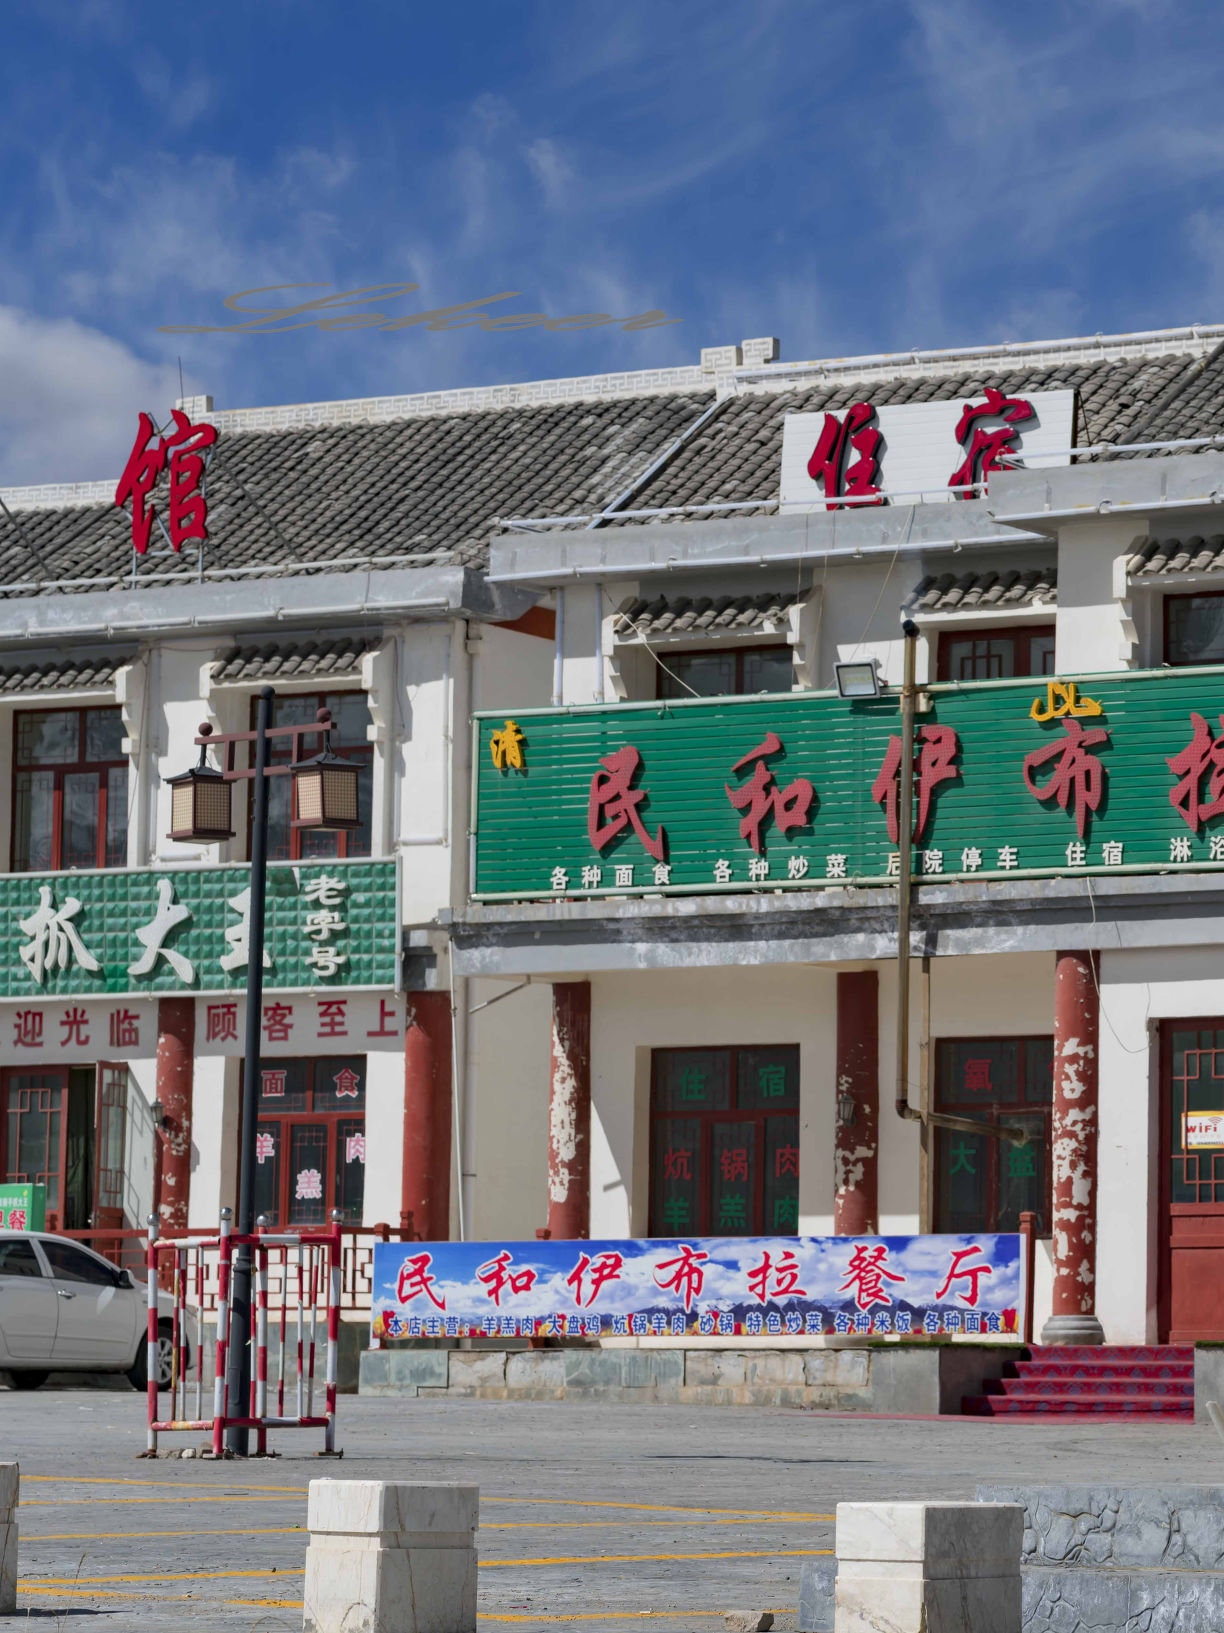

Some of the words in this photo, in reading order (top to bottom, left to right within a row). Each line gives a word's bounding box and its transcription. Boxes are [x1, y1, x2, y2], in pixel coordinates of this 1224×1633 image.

[808, 388, 1034, 511] 住宿
[114, 409, 218, 554] 馆
[490, 720, 525, 773] 清
[550, 861, 672, 890] 各种面食
[713, 854, 847, 883] 各种炒菜
[886, 845, 1018, 875] 后院停车
[1065, 840, 1123, 866] 住宿
[19, 879, 272, 984] 抓大王
[303, 874, 348, 977] 老字号
[0, 1006, 140, 1047] 迎光临
[206, 999, 398, 1042] 顾客至上
[261, 1068, 360, 1097] 面食
[680, 1064, 786, 1100] 住宿
[0, 1209, 26, 1231] 餐
[397, 1244, 993, 1311] 民和伊布拉餐厅
[547, 1313, 599, 1335] 大盘鸡
[699, 1313, 734, 1333] 砂锅
[746, 1312, 822, 1333] 特色炒菜
[836, 1312, 911, 1333] 各种米饭
[925, 1311, 1001, 1333] 各种面食
